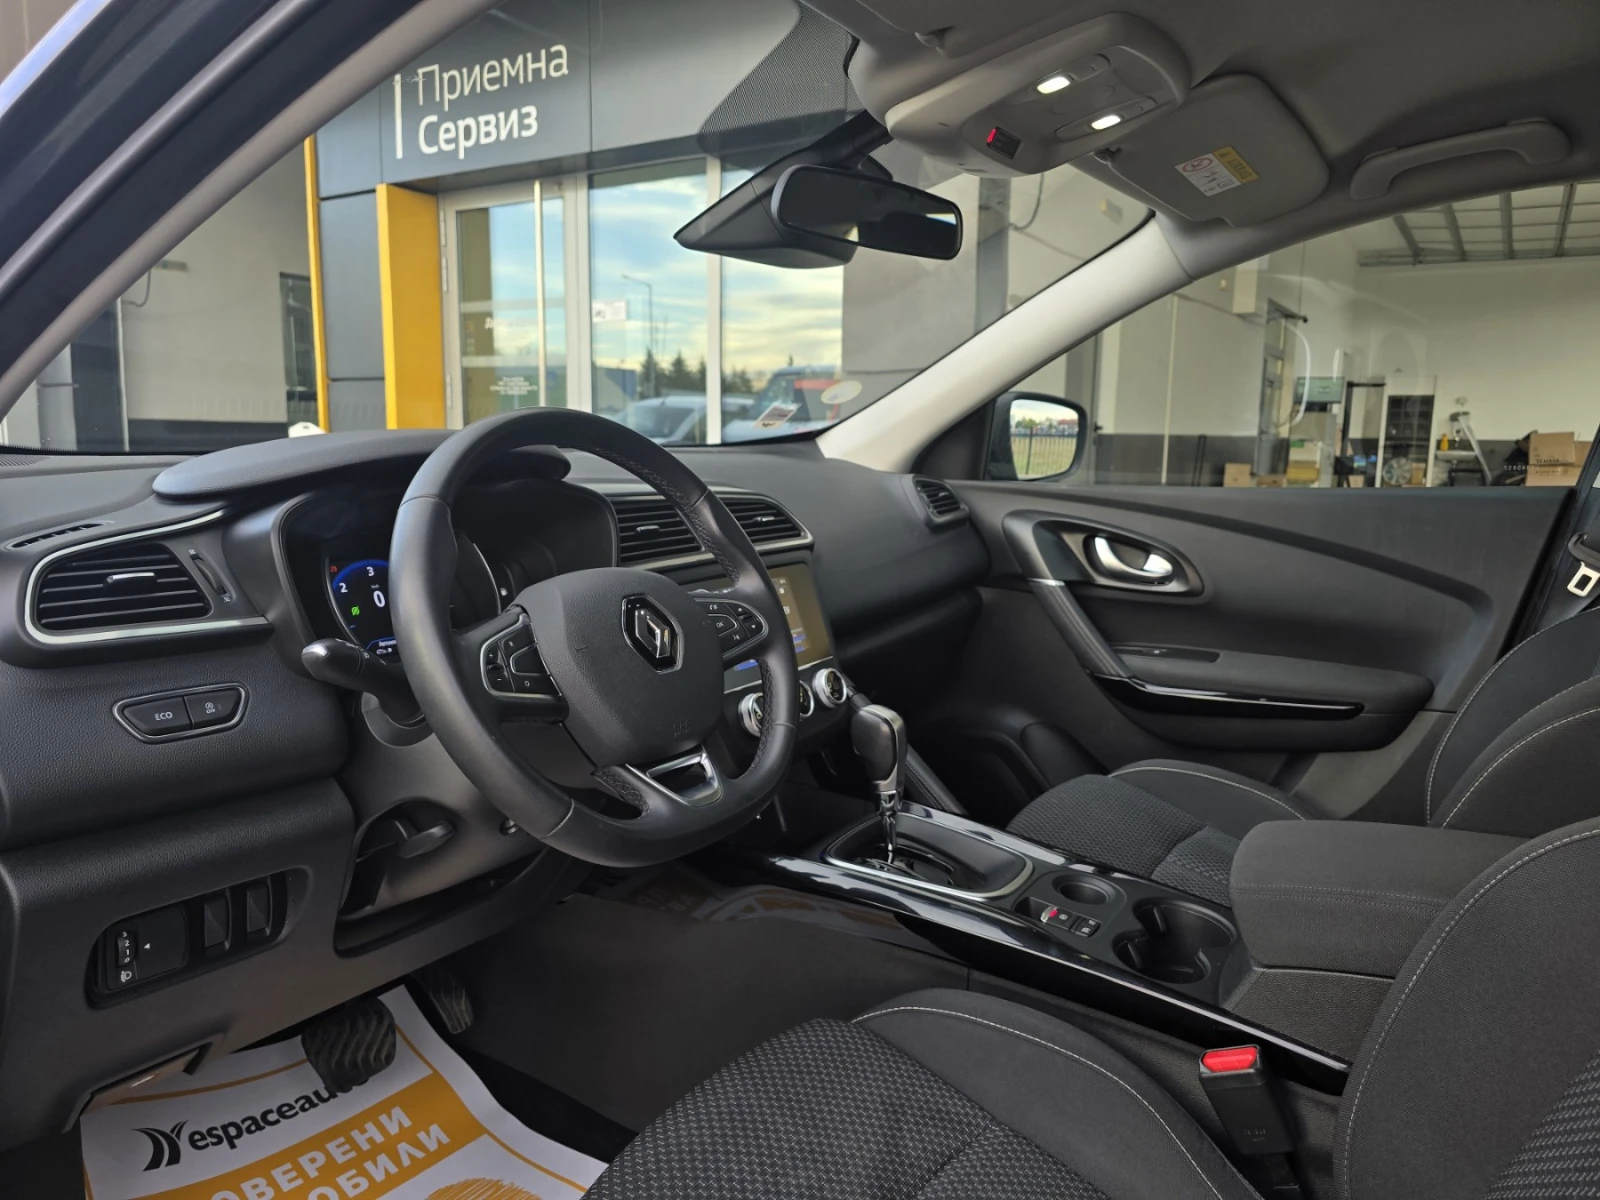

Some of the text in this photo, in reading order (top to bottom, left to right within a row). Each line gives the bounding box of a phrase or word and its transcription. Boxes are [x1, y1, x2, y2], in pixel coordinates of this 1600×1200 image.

[417, 43, 569, 112] Приемна
[418, 105, 539, 160] Сервиз
[366, 566, 375, 577] 3
[339, 583, 348, 593] 2
[373, 590, 385, 607] 0
[154, 711, 173, 720] ECO
